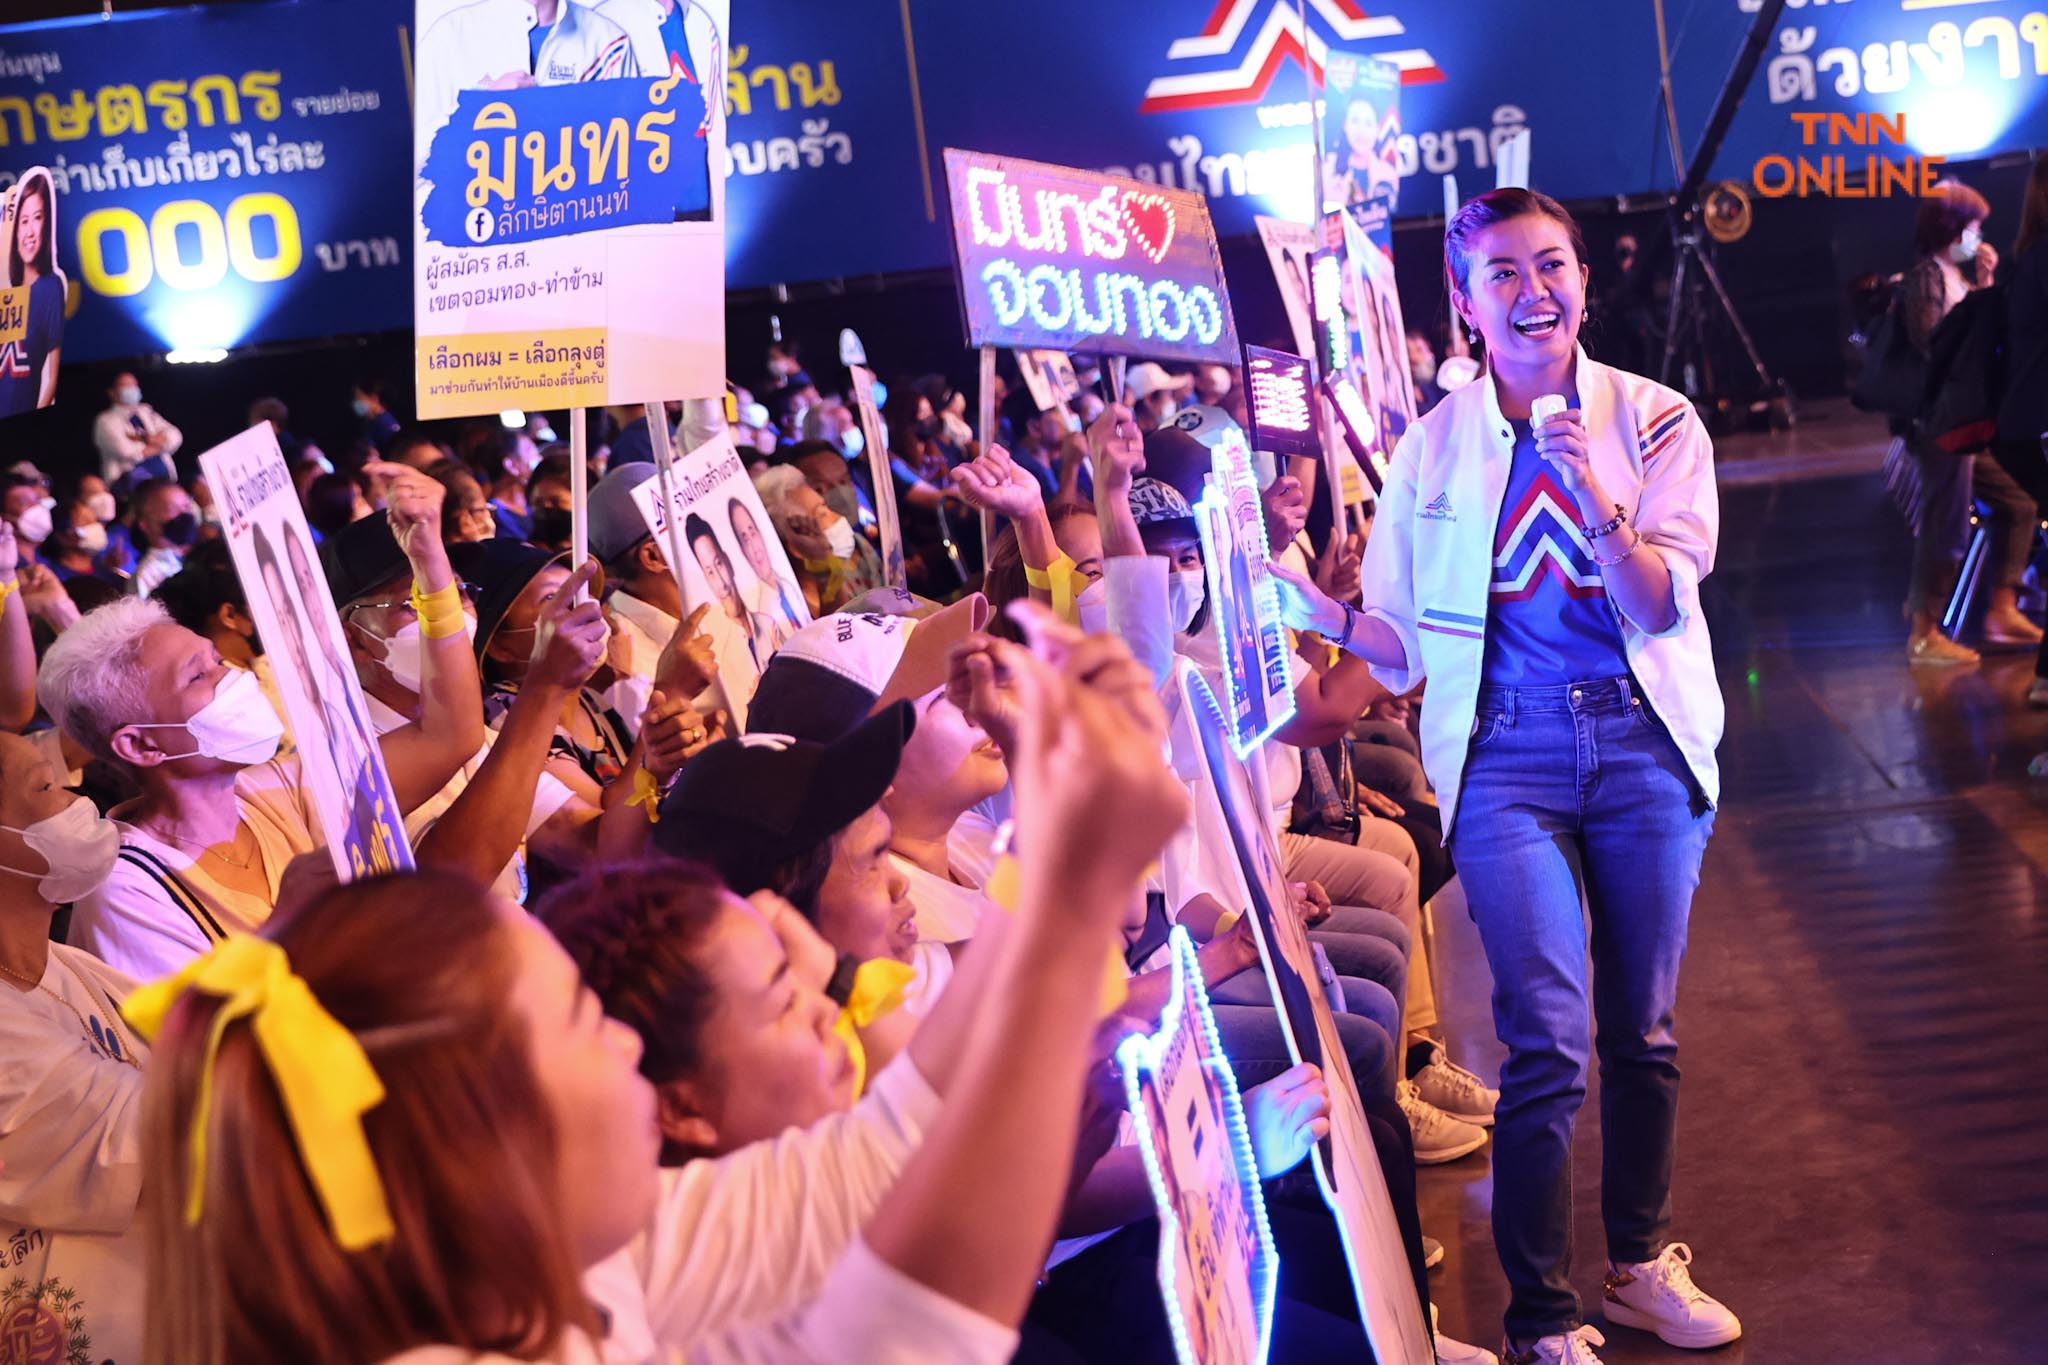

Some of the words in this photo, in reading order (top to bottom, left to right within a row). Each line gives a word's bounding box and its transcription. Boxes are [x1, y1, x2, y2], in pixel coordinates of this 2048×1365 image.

[465, 72, 681, 207] มินทร์
[725, 118, 853, 177] บครัว
[499, 179, 630, 236] ลักษิตานนท์
[315, 237, 400, 272] บาท
[427, 252, 490, 289] ผู้สมัคร
[497, 250, 530, 271] ส.ส.
[429, 266, 603, 312] เขตจอมทอง-ท่าข้าม
[429, 345, 501, 370] เลือกผม
[526, 339, 606, 370] เลือกลุงตู่
